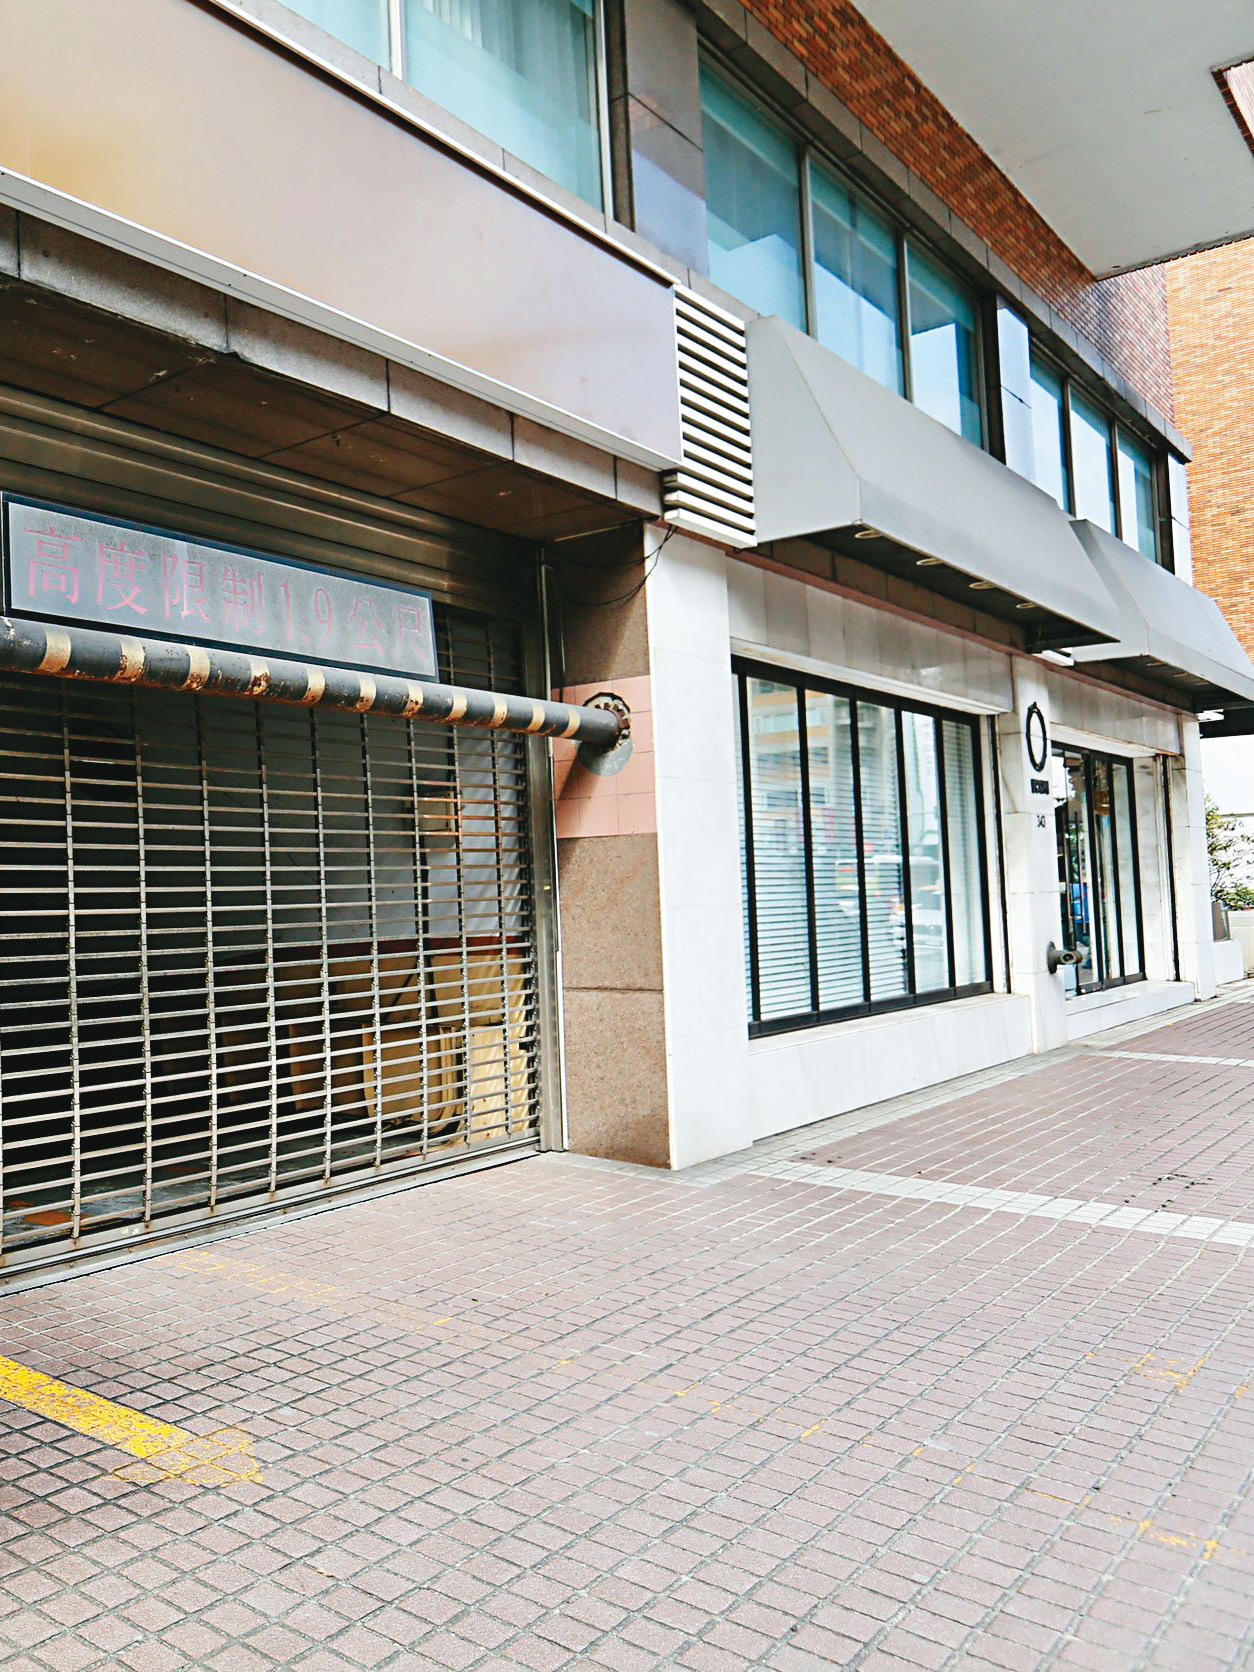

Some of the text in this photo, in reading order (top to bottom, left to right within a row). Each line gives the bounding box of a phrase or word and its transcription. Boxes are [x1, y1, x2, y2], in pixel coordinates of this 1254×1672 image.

[23, 525, 428, 661] 高度限制1.9公尺
